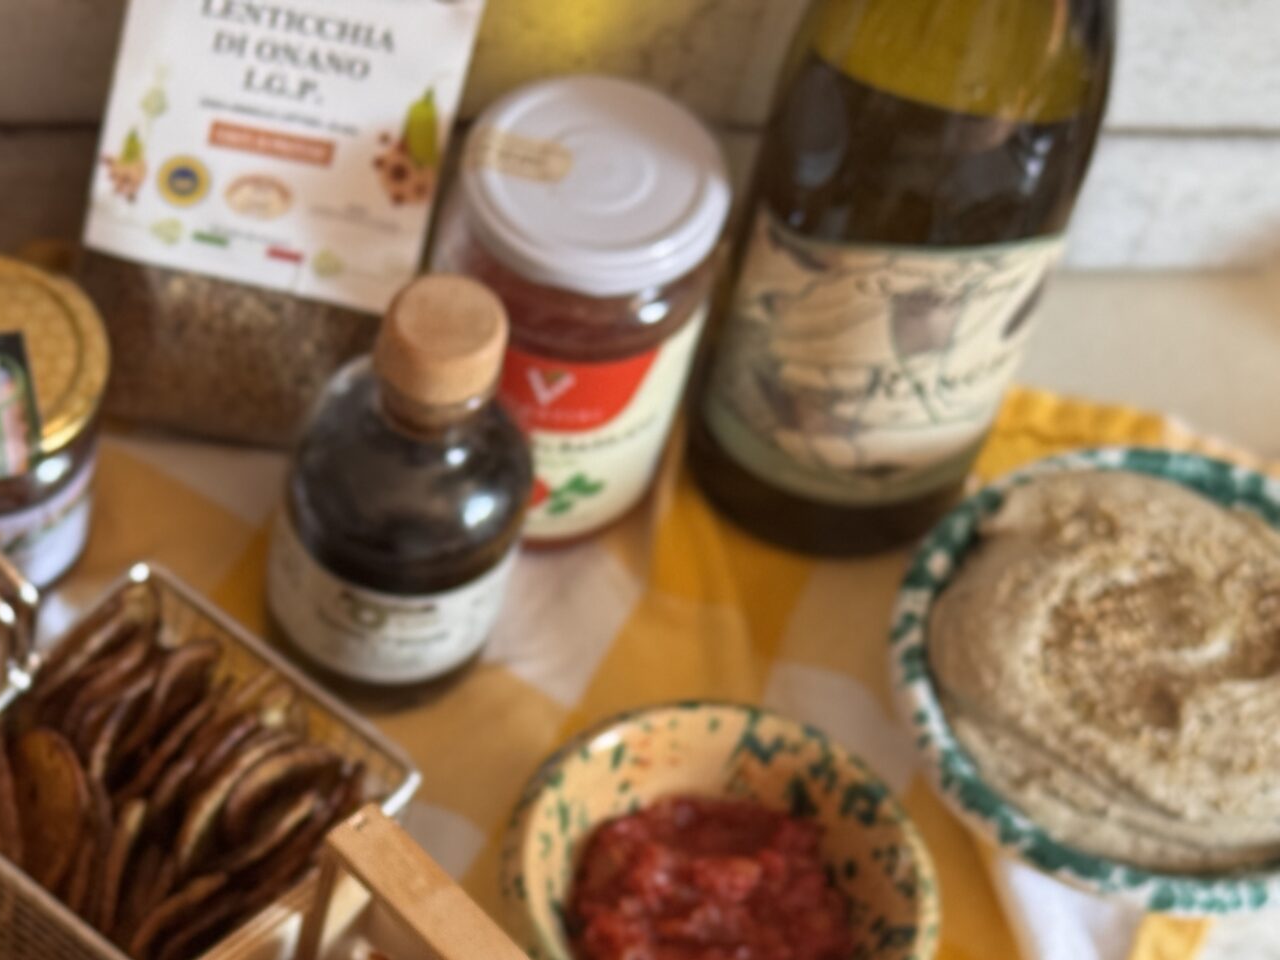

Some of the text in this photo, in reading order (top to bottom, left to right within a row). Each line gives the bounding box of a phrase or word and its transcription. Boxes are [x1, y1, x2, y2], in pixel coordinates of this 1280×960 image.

[200, 0, 396, 54] LENTICCHIA
[212, 29, 371, 81] DI ONANO
